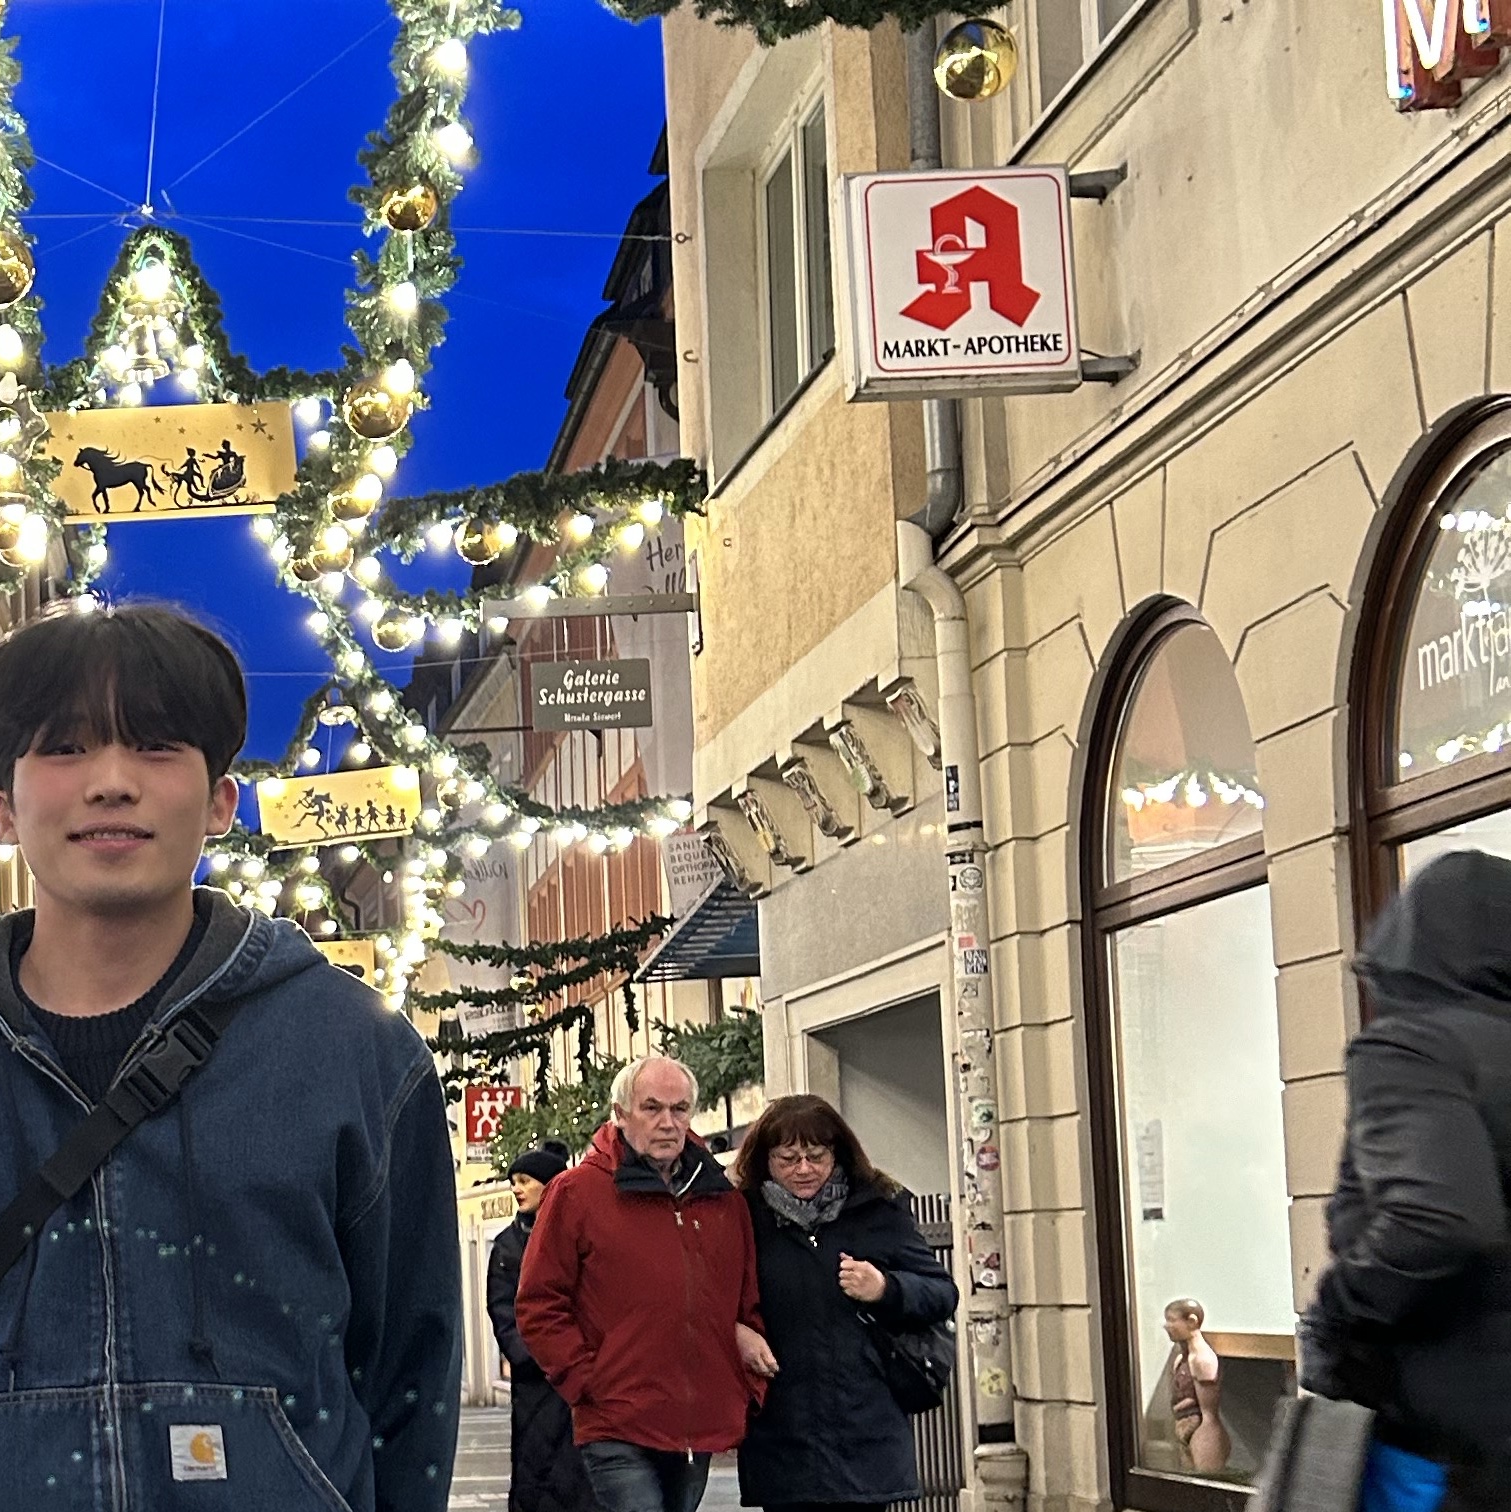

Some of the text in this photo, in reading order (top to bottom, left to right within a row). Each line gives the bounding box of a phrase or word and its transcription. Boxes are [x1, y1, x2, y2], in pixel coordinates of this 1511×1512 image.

[882, 333, 1063, 360] MARKT-APOTHEKE
[563, 668, 620, 690] Galerie
[538, 686, 646, 707] Schustergasse
